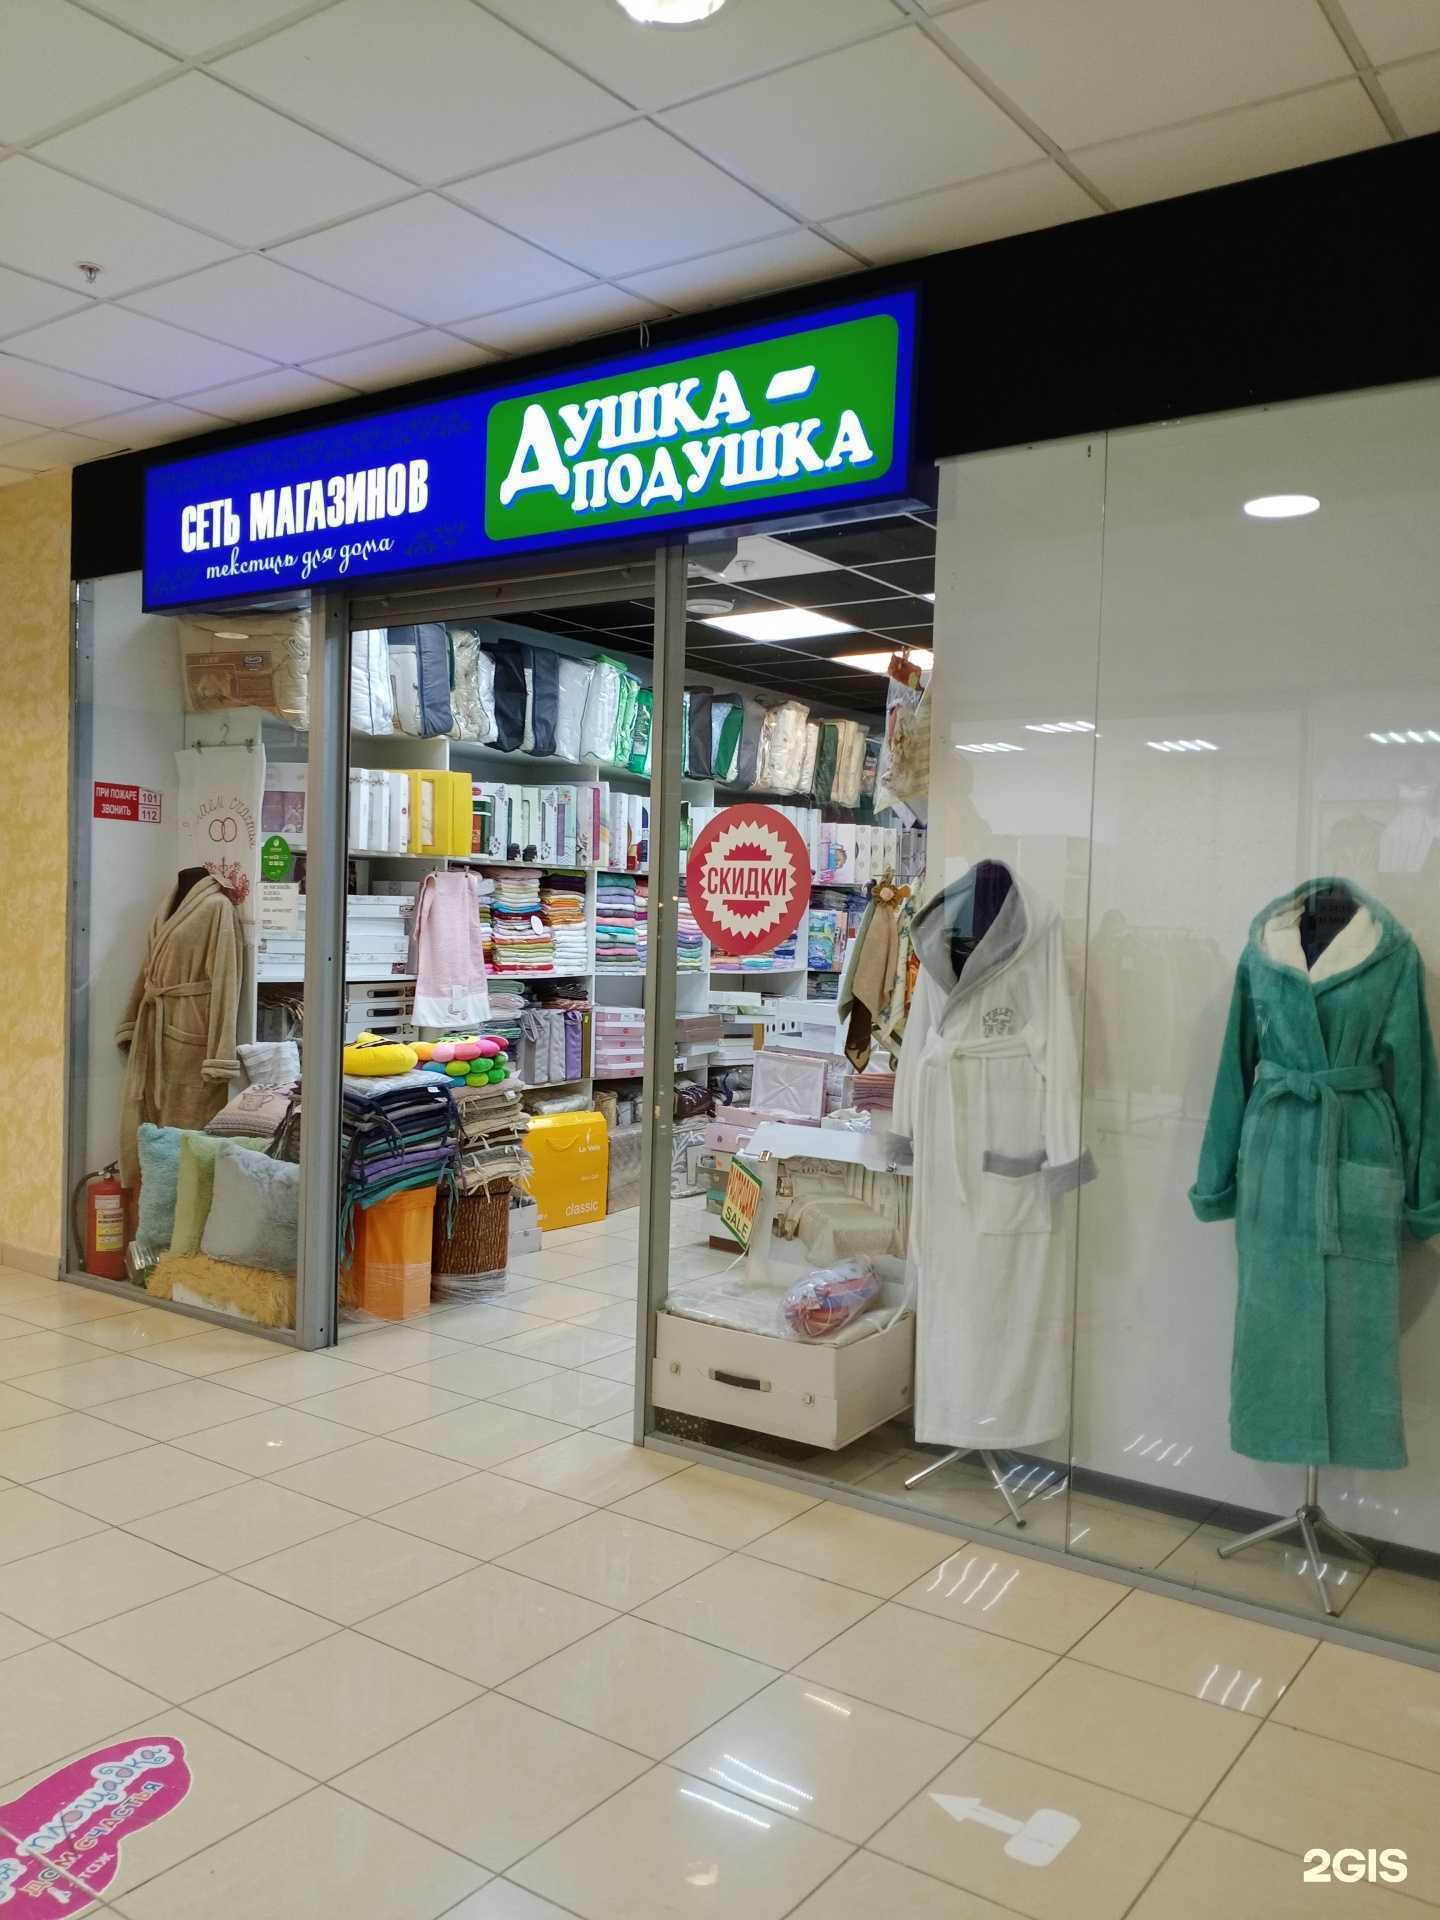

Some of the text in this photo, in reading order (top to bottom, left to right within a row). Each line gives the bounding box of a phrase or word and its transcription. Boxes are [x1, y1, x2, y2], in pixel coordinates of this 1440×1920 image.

[570, 409, 874, 513] ПОДУШКА
[181, 458, 429, 553] СЕТЬ МАГАЗИНОВ
[206, 536, 396, 580] текстиль для дома
[96, 786, 138, 801] ПРИ ПОЖАРЕ
[101, 803, 132, 816] ЗВОНИТЬ
[142, 792, 158, 803] 101
[142, 809, 158, 821] 112
[707, 866, 788, 899] СКИДКИ
[565, 1199, 599, 1218] classic
[725, 1206, 749, 1240] SALE
[73, 1779, 166, 1851] СЧАСТЬЯ
